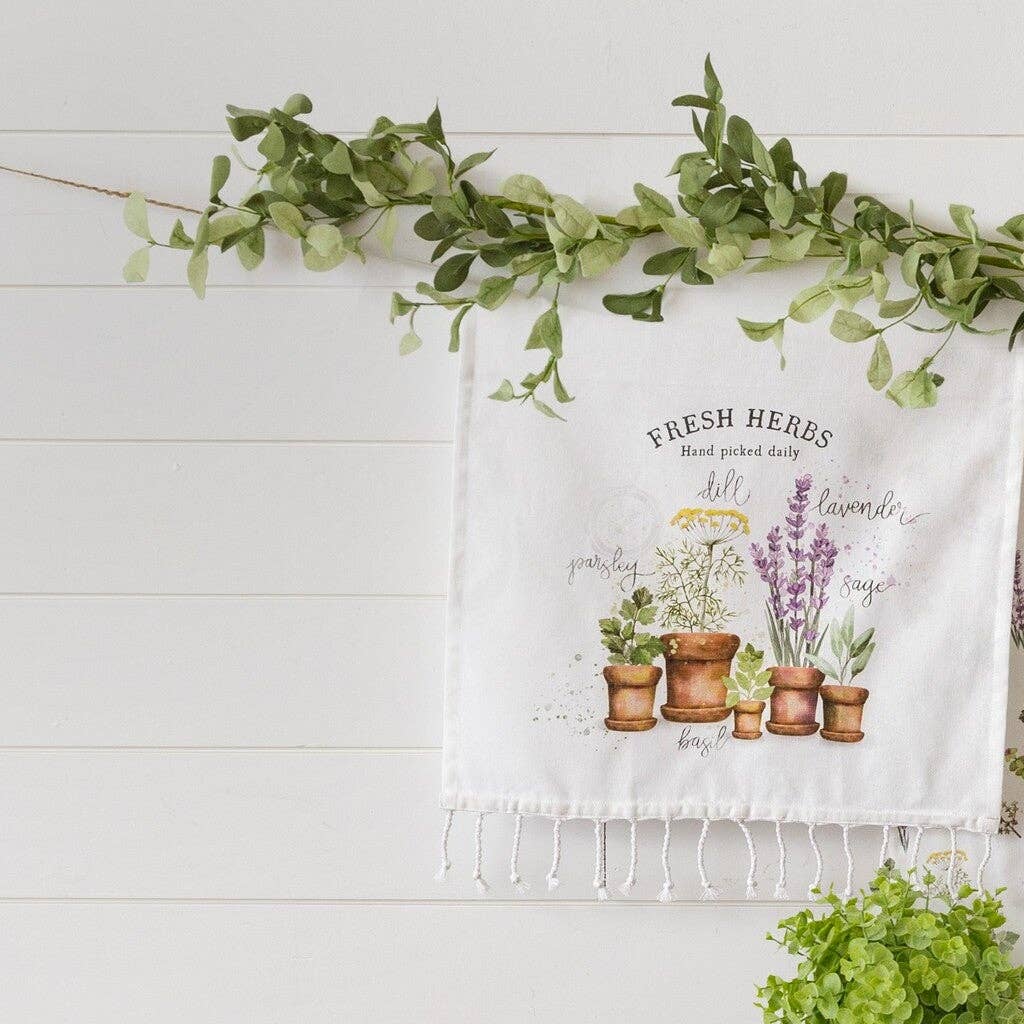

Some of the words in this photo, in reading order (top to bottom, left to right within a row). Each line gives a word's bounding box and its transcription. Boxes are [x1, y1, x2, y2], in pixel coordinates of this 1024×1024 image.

[646, 408, 734, 449] FRESH
[746, 408, 833, 449] HERBS
[680, 445, 714, 457] Hand
[720, 445, 762, 460] picked
[768, 445, 800, 461] daily
[697, 468, 751, 506] dill
[810, 489, 931, 526] lavender
[566, 547, 656, 592] parsley
[839, 575, 893, 608] sage
